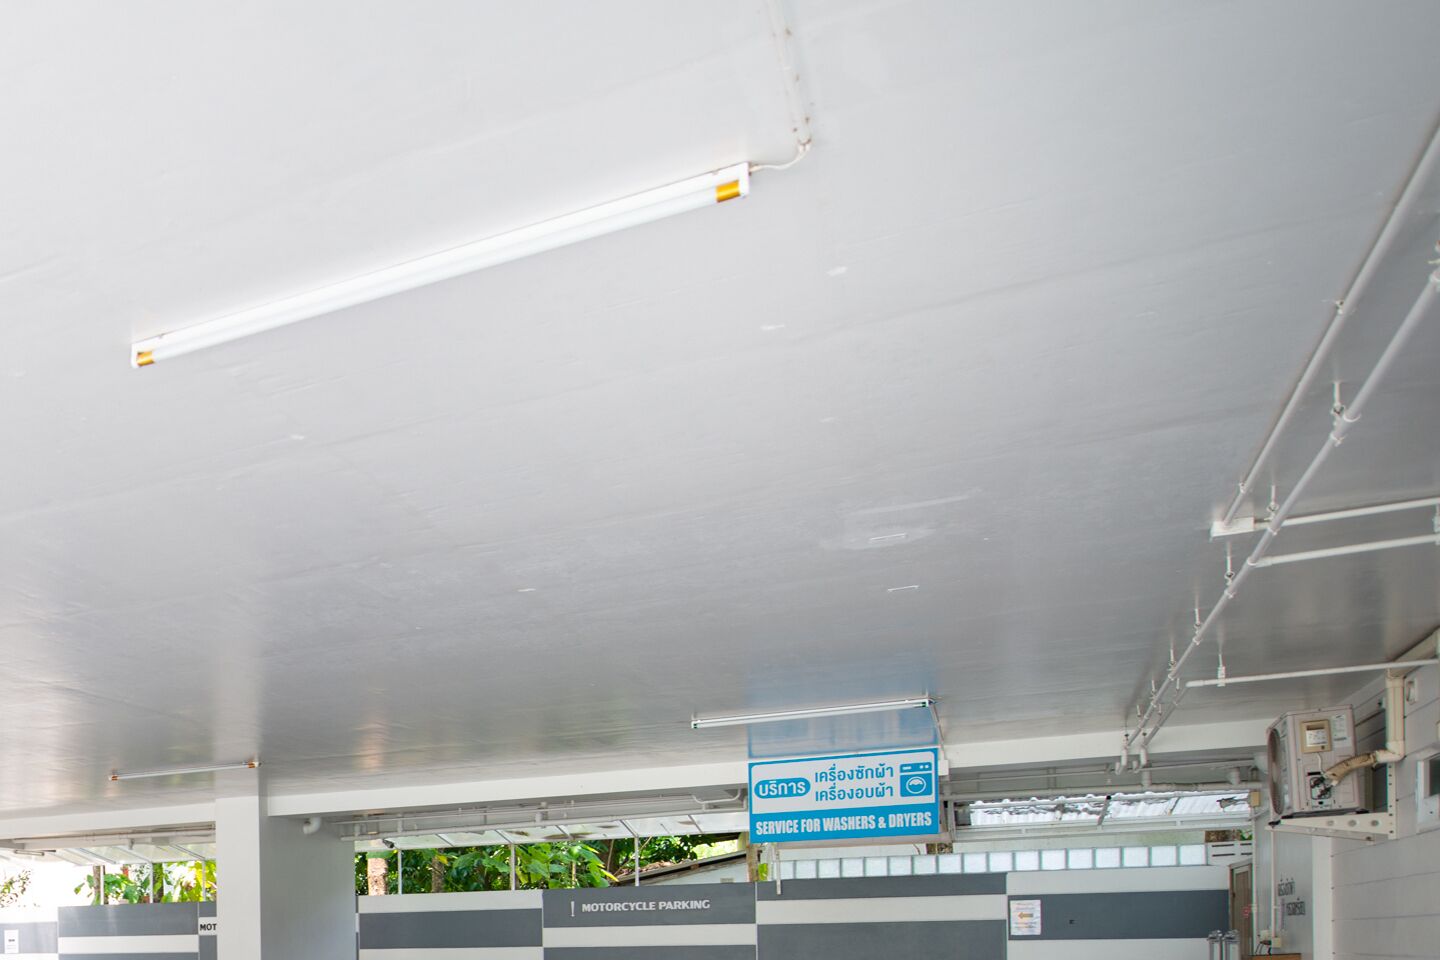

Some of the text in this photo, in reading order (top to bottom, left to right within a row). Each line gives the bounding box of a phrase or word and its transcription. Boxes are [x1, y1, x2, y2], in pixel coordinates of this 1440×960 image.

[815, 763, 894, 783] เครื่องซักผ้า
[759, 780, 807, 797] บริการ
[815, 782, 894, 802] เครื่องอบผ้า
[756, 811, 932, 836] SERVICE FOR WASHERS & DRYERS
[581, 902, 656, 913] MOTORCYCLE
[659, 899, 711, 910] PARKING
